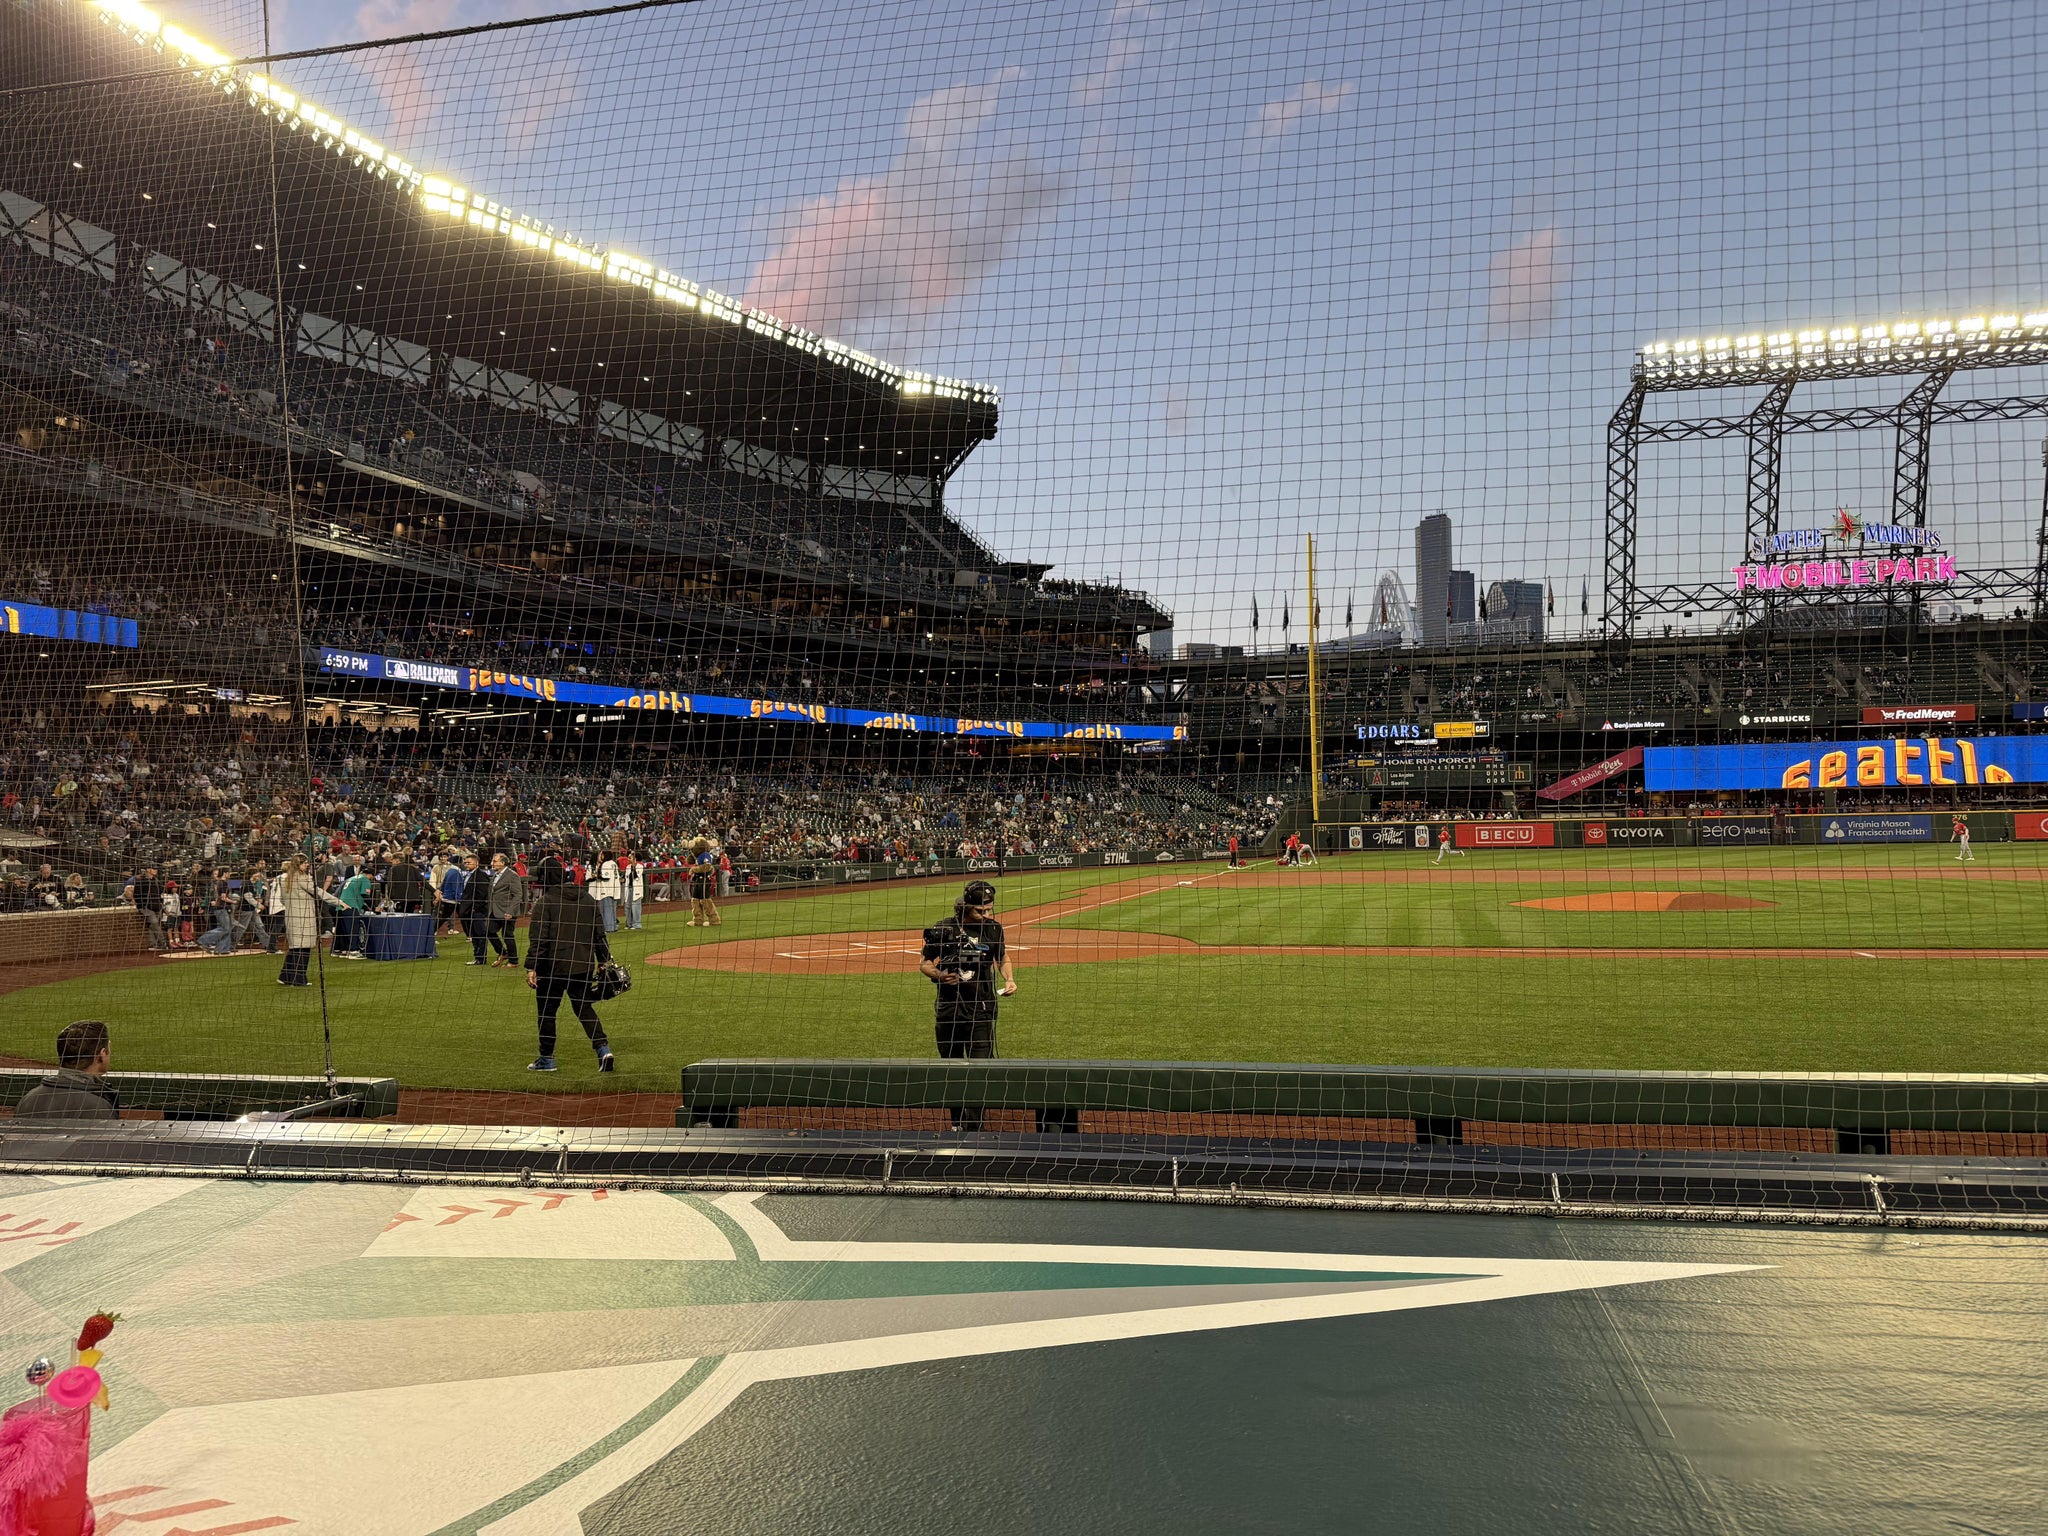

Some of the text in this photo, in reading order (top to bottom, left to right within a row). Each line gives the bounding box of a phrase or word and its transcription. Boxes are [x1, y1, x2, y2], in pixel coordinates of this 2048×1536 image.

[1751, 521, 1942, 557] SEATTLE MARINERS
[1731, 555, 1959, 590] T-MOBILE PARK
[325, 653, 369, 672] 6:59 PM
[409, 662, 459, 686] BALLPARK
[1753, 714, 1811, 724] STARBUCKS
[1475, 725, 1487, 733] CAT
[1613, 721, 1643, 730] Benjamin
[1384, 758, 1415, 766] HOME
[1438, 757, 1477, 765] PORCH
[1847, 820, 1911, 829] Virginia Mason
[1611, 828, 1664, 838] TOYOTA
[1702, 825, 1741, 838] eero
[1848, 828, 1927, 837] Franciscan Health
[1038, 854, 1074, 867] Great Clips
[1104, 852, 1130, 864] STIHL
